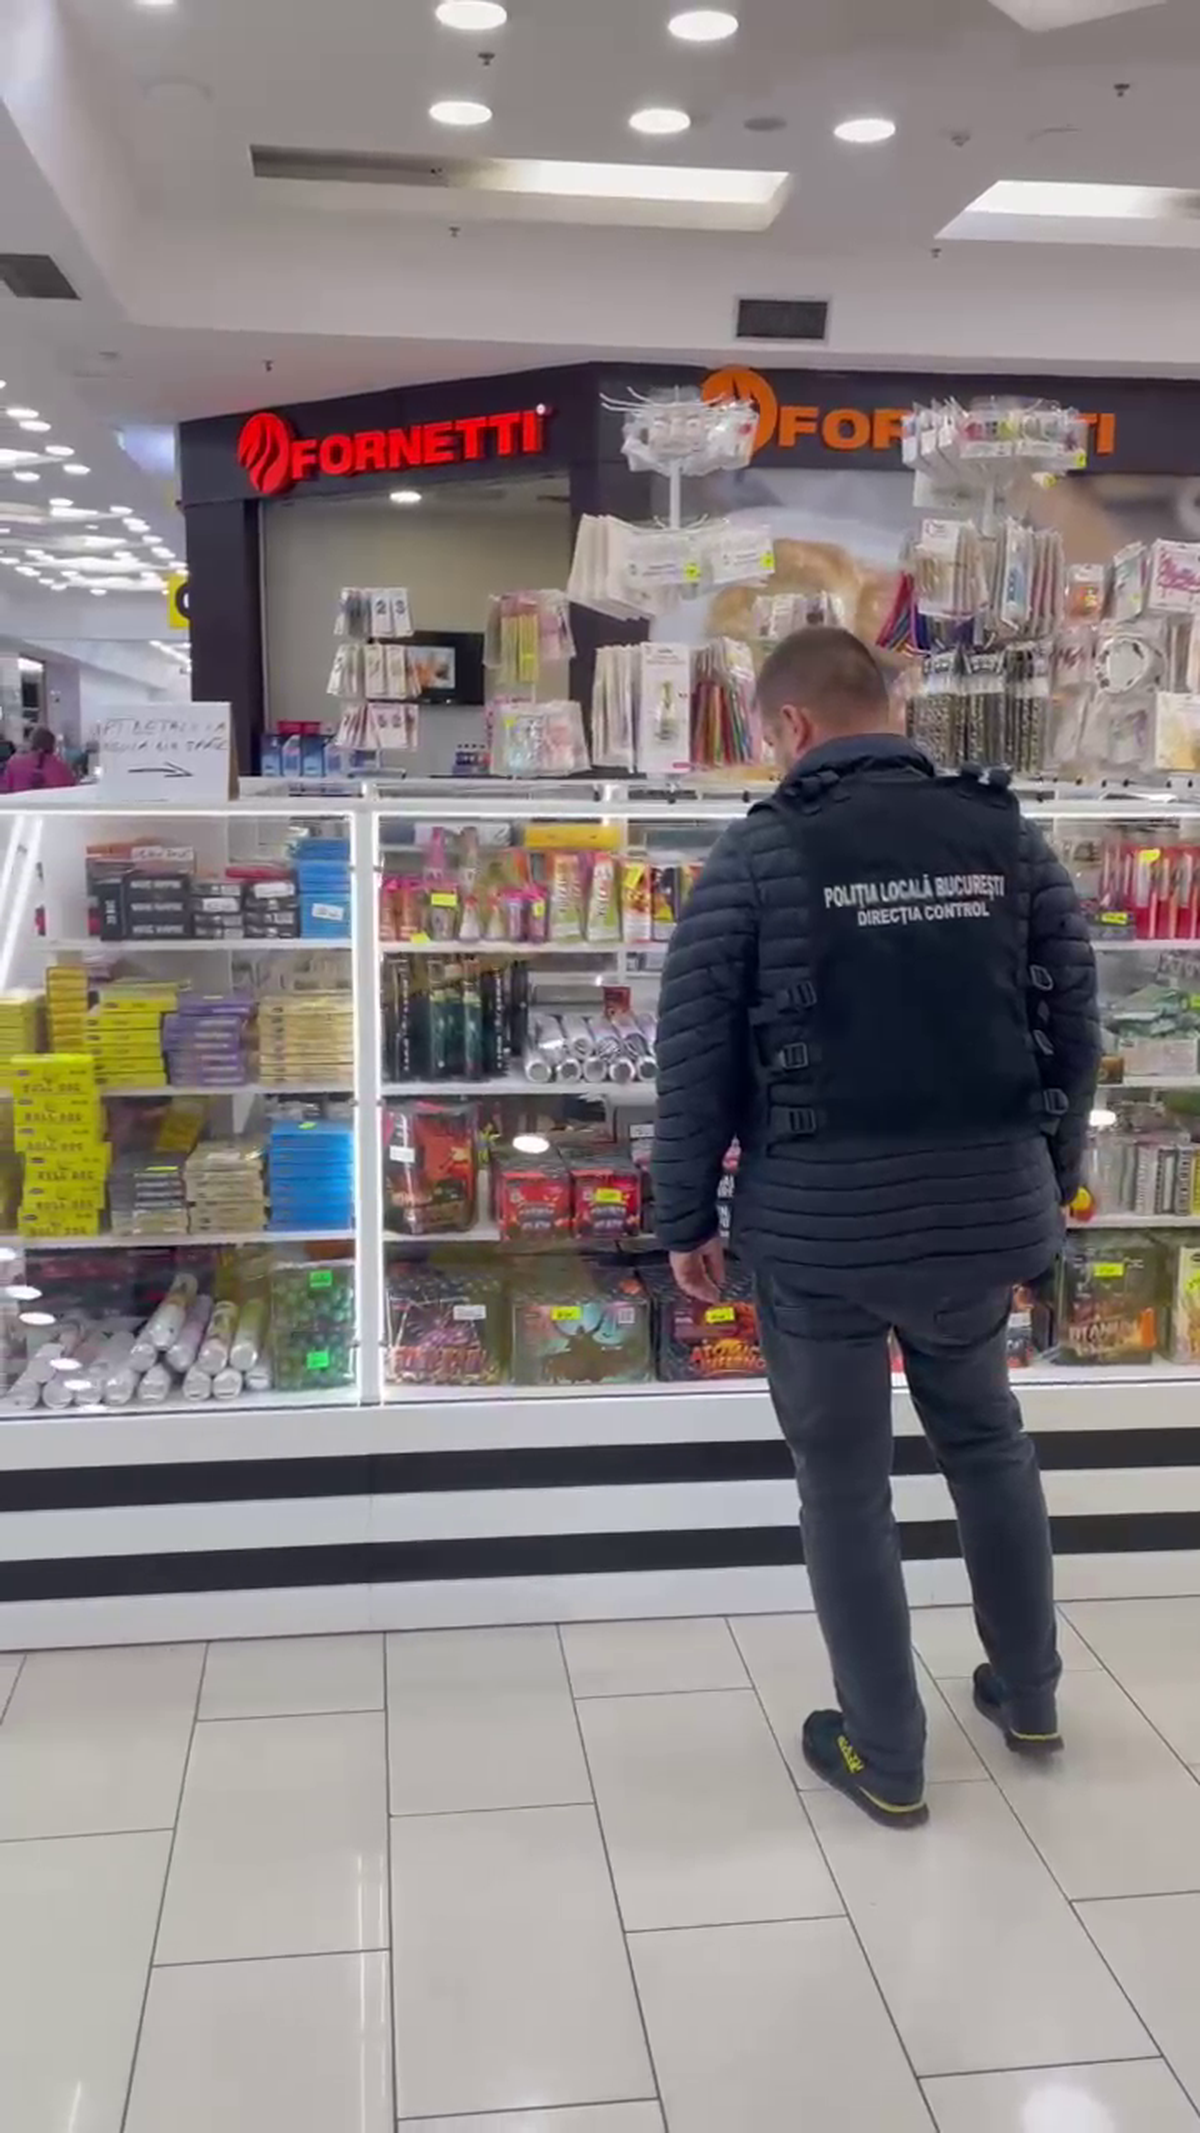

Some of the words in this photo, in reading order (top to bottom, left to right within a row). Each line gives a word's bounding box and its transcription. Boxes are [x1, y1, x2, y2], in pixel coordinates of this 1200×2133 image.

[292, 409, 543, 481] FORNETTI
[824, 883, 878, 908] POLIȚIA
[881, 874, 933, 902] LOCALĂ
[934, 874, 1005, 901] BUCUREȘTI
[857, 906, 923, 927] DIRECȚIA
[925, 901, 990, 921] CONTROL
